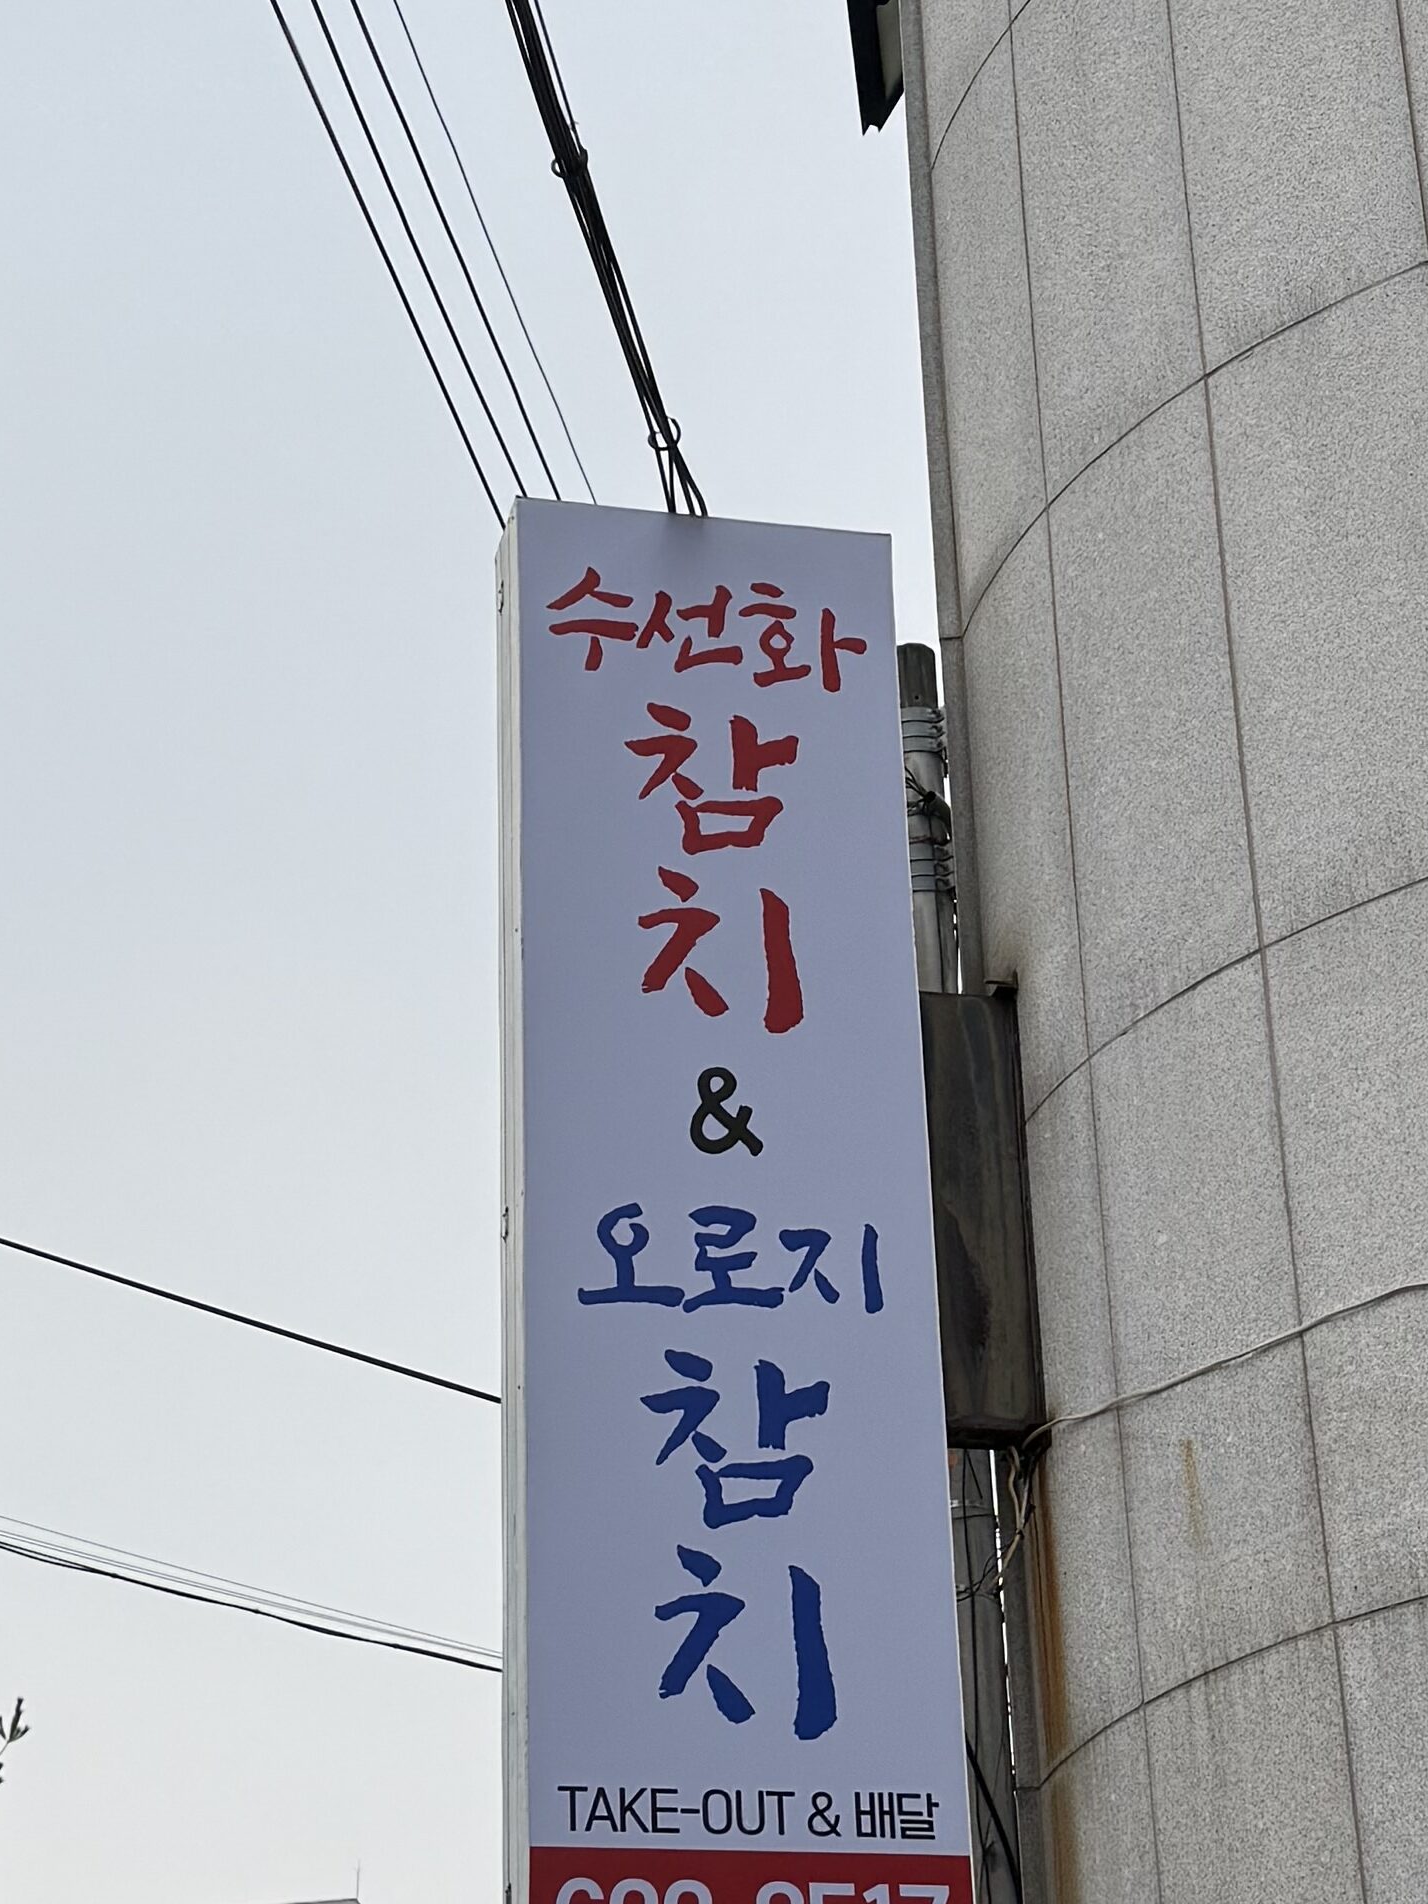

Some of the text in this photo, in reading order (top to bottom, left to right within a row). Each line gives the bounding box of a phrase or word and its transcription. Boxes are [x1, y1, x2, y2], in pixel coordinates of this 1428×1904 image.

[546, 566, 867, 693] 수선화
[624, 702, 804, 1034] 참치
[689, 1066, 764, 1157] &
[576, 1202, 885, 1314] 오로지
[640, 1348, 839, 1742] 참치
[556, 1784, 941, 1842] TAKE-OUT & 배달
